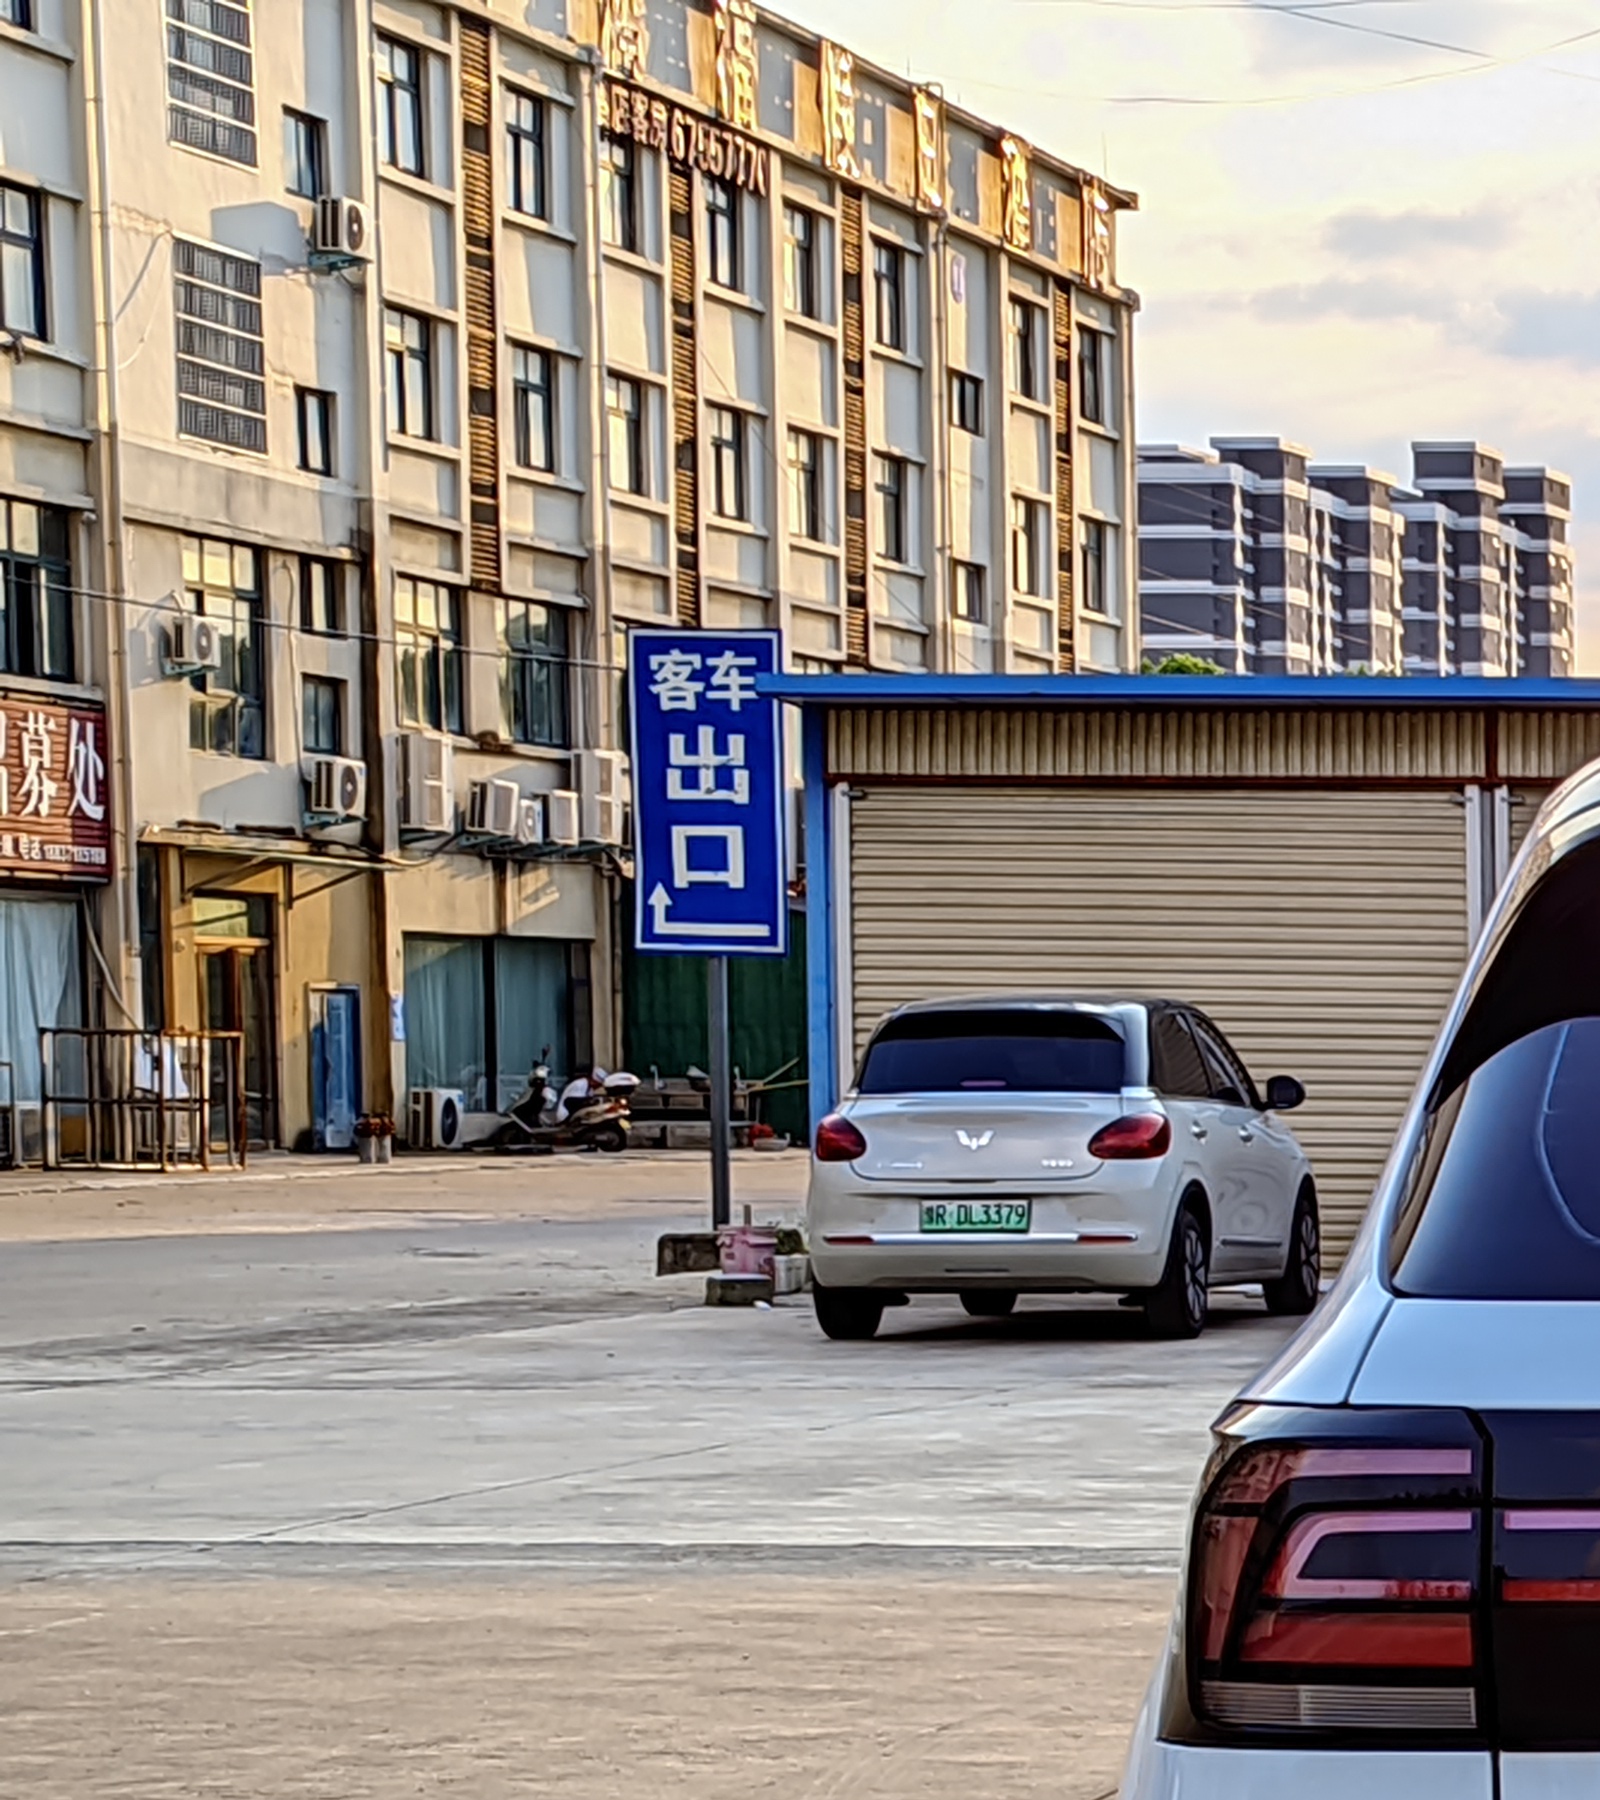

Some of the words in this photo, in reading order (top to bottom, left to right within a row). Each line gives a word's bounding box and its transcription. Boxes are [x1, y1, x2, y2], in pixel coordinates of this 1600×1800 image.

[648, 649, 760, 711] 客车
[0, 710, 105, 821] 募处
[666, 724, 750, 889] 出口
